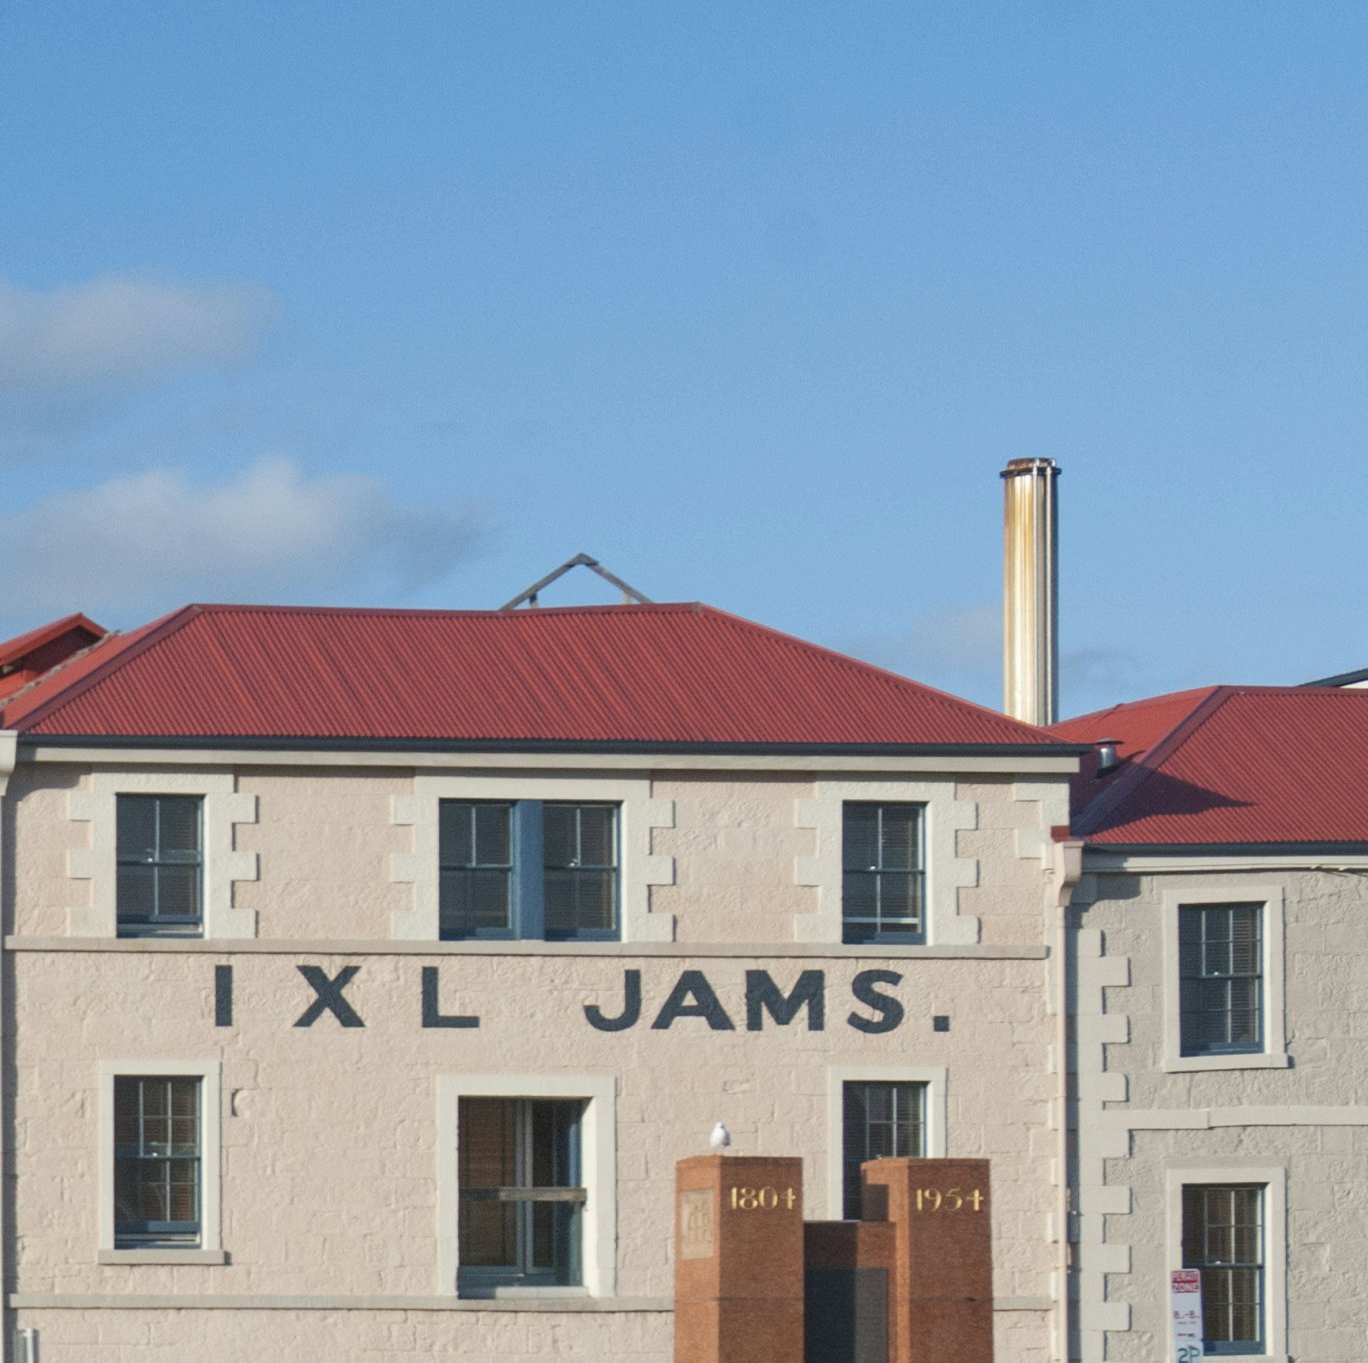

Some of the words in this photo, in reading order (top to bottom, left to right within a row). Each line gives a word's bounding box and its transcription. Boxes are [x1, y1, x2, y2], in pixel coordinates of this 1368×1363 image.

[585, 968, 950, 1034] JAMS.
[730, 1187, 796, 1210] 1804
[916, 1188, 984, 1211] 1954
[1177, 1344, 1201, 1363] 2P
